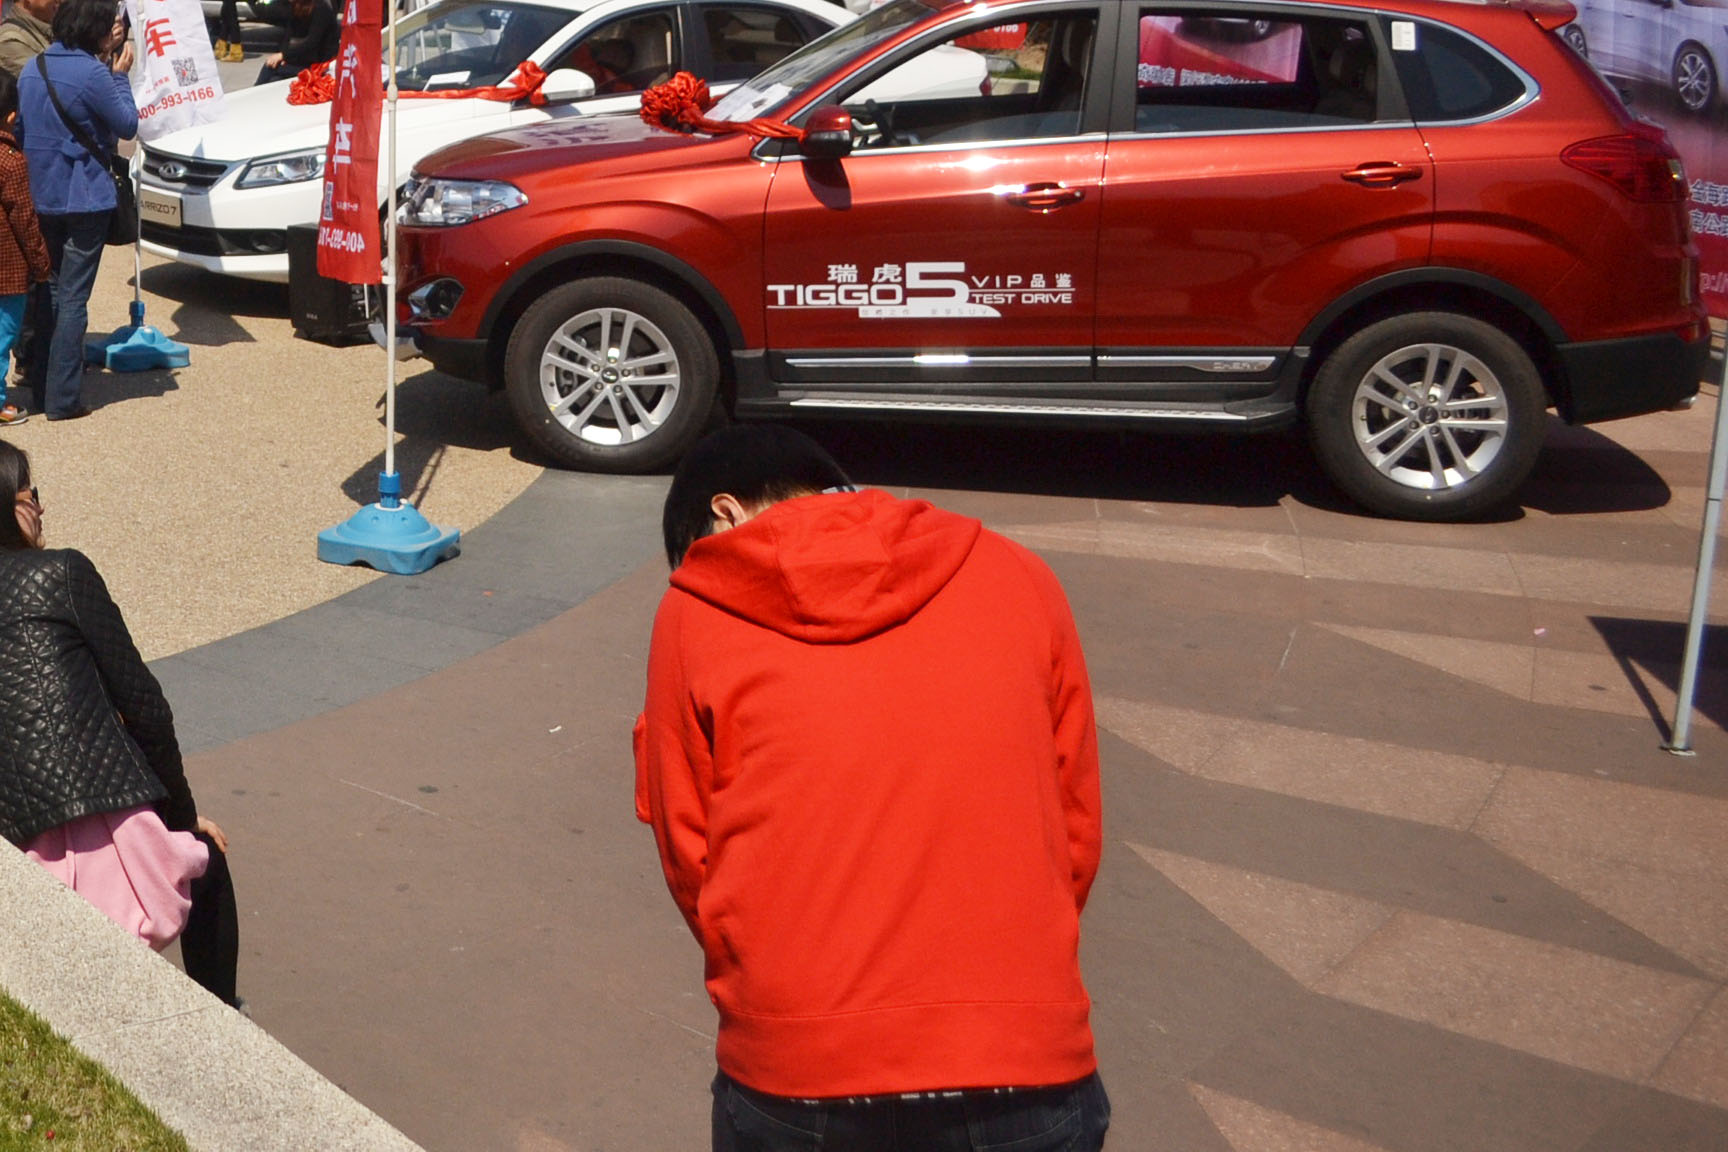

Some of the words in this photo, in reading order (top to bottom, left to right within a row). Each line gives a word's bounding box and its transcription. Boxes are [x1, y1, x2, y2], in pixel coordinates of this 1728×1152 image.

[170, 206, 177, 215] 7
[827, 264, 902, 283] 瑞虎
[767, 284, 906, 306] TIGGO
[905, 261, 970, 308] 5
[972, 293, 1016, 305] TEST
[1021, 293, 1073, 305] DRIVE
